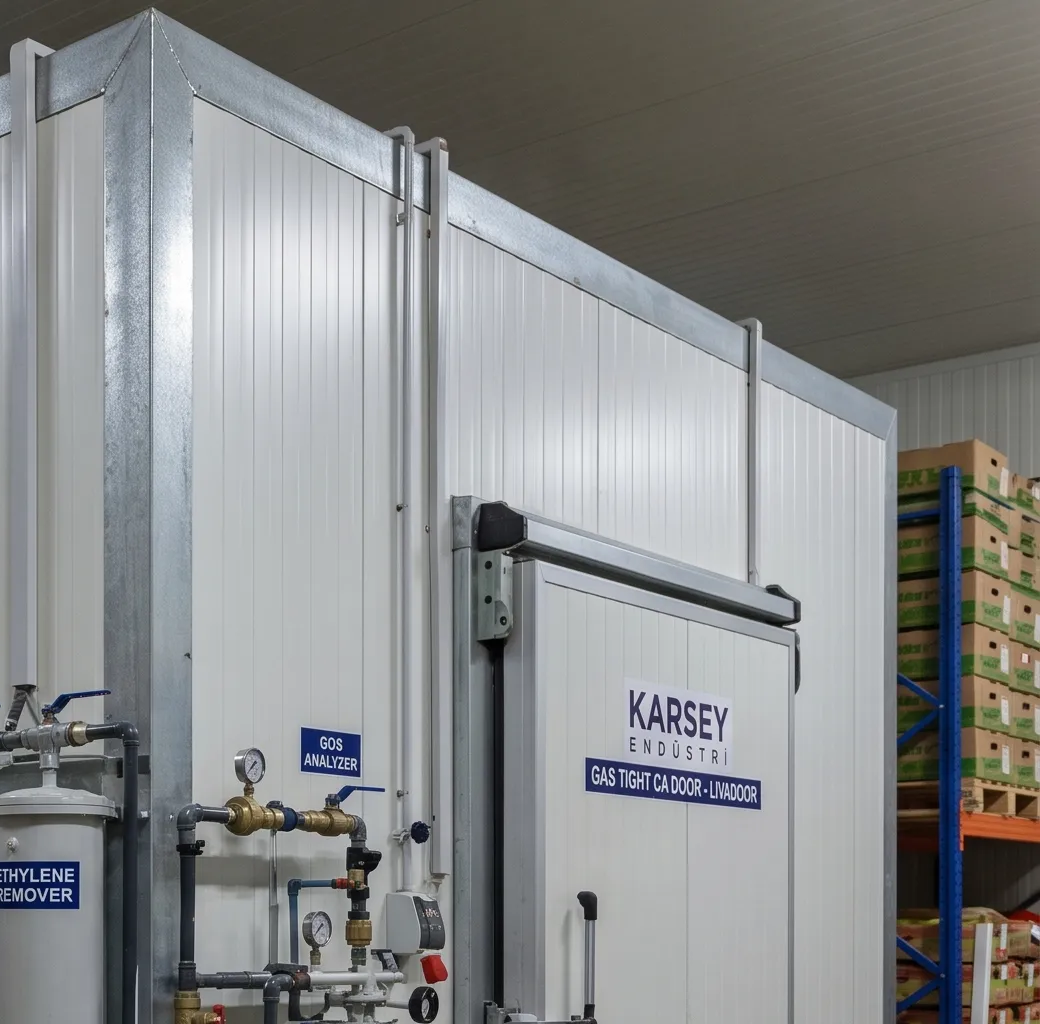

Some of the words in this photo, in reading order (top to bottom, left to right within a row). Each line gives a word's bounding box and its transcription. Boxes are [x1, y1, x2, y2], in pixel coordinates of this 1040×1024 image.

[629, 689, 729, 742] KARSEY
[319, 735, 343, 752] GOS
[303, 752, 358, 771] ANALYZER
[591, 765, 616, 787] GAS
[618, 768, 652, 792] TIGHT
[653, 773, 670, 793] CA
[671, 775, 702, 797] DOOR
[709, 780, 758, 804] LIVADOOR
